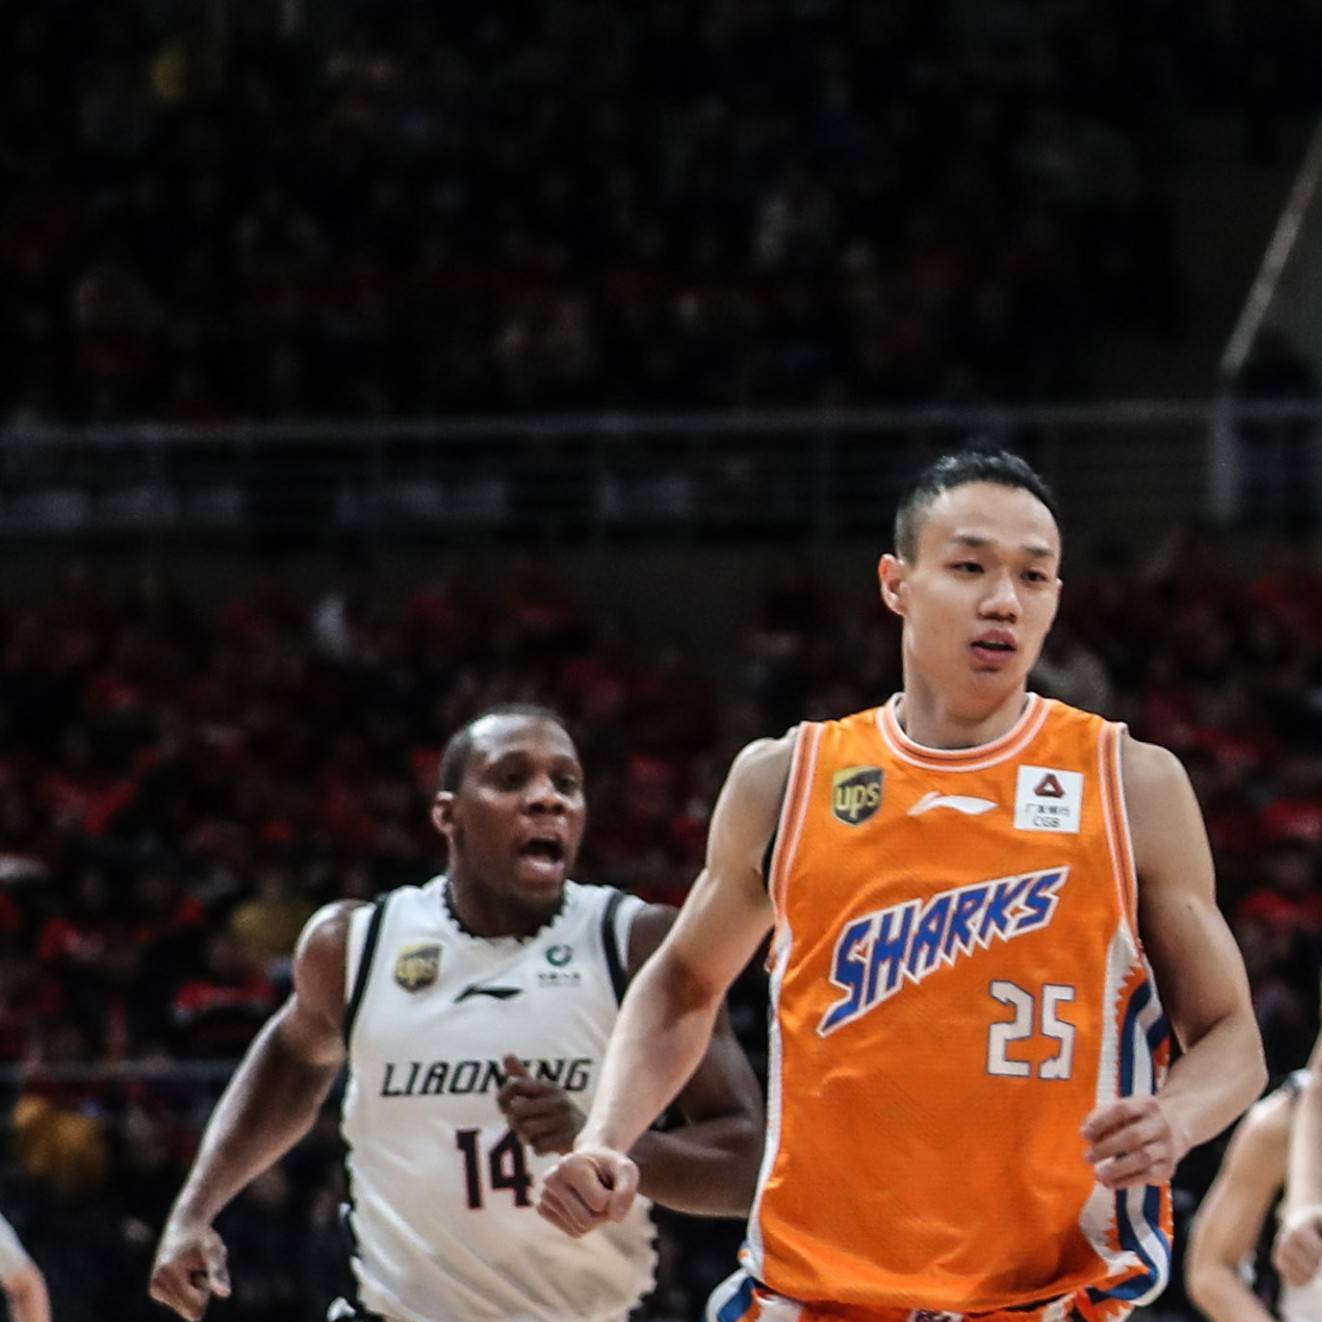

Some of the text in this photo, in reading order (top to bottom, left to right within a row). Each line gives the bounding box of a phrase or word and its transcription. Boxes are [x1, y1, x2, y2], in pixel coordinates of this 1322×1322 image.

[836, 783, 880, 819] ups
[816, 864, 1071, 1038] SHARKS
[987, 979, 1076, 1081] 25
[381, 1056, 593, 1098] LIAONNG
[455, 1127, 534, 1210] 14
